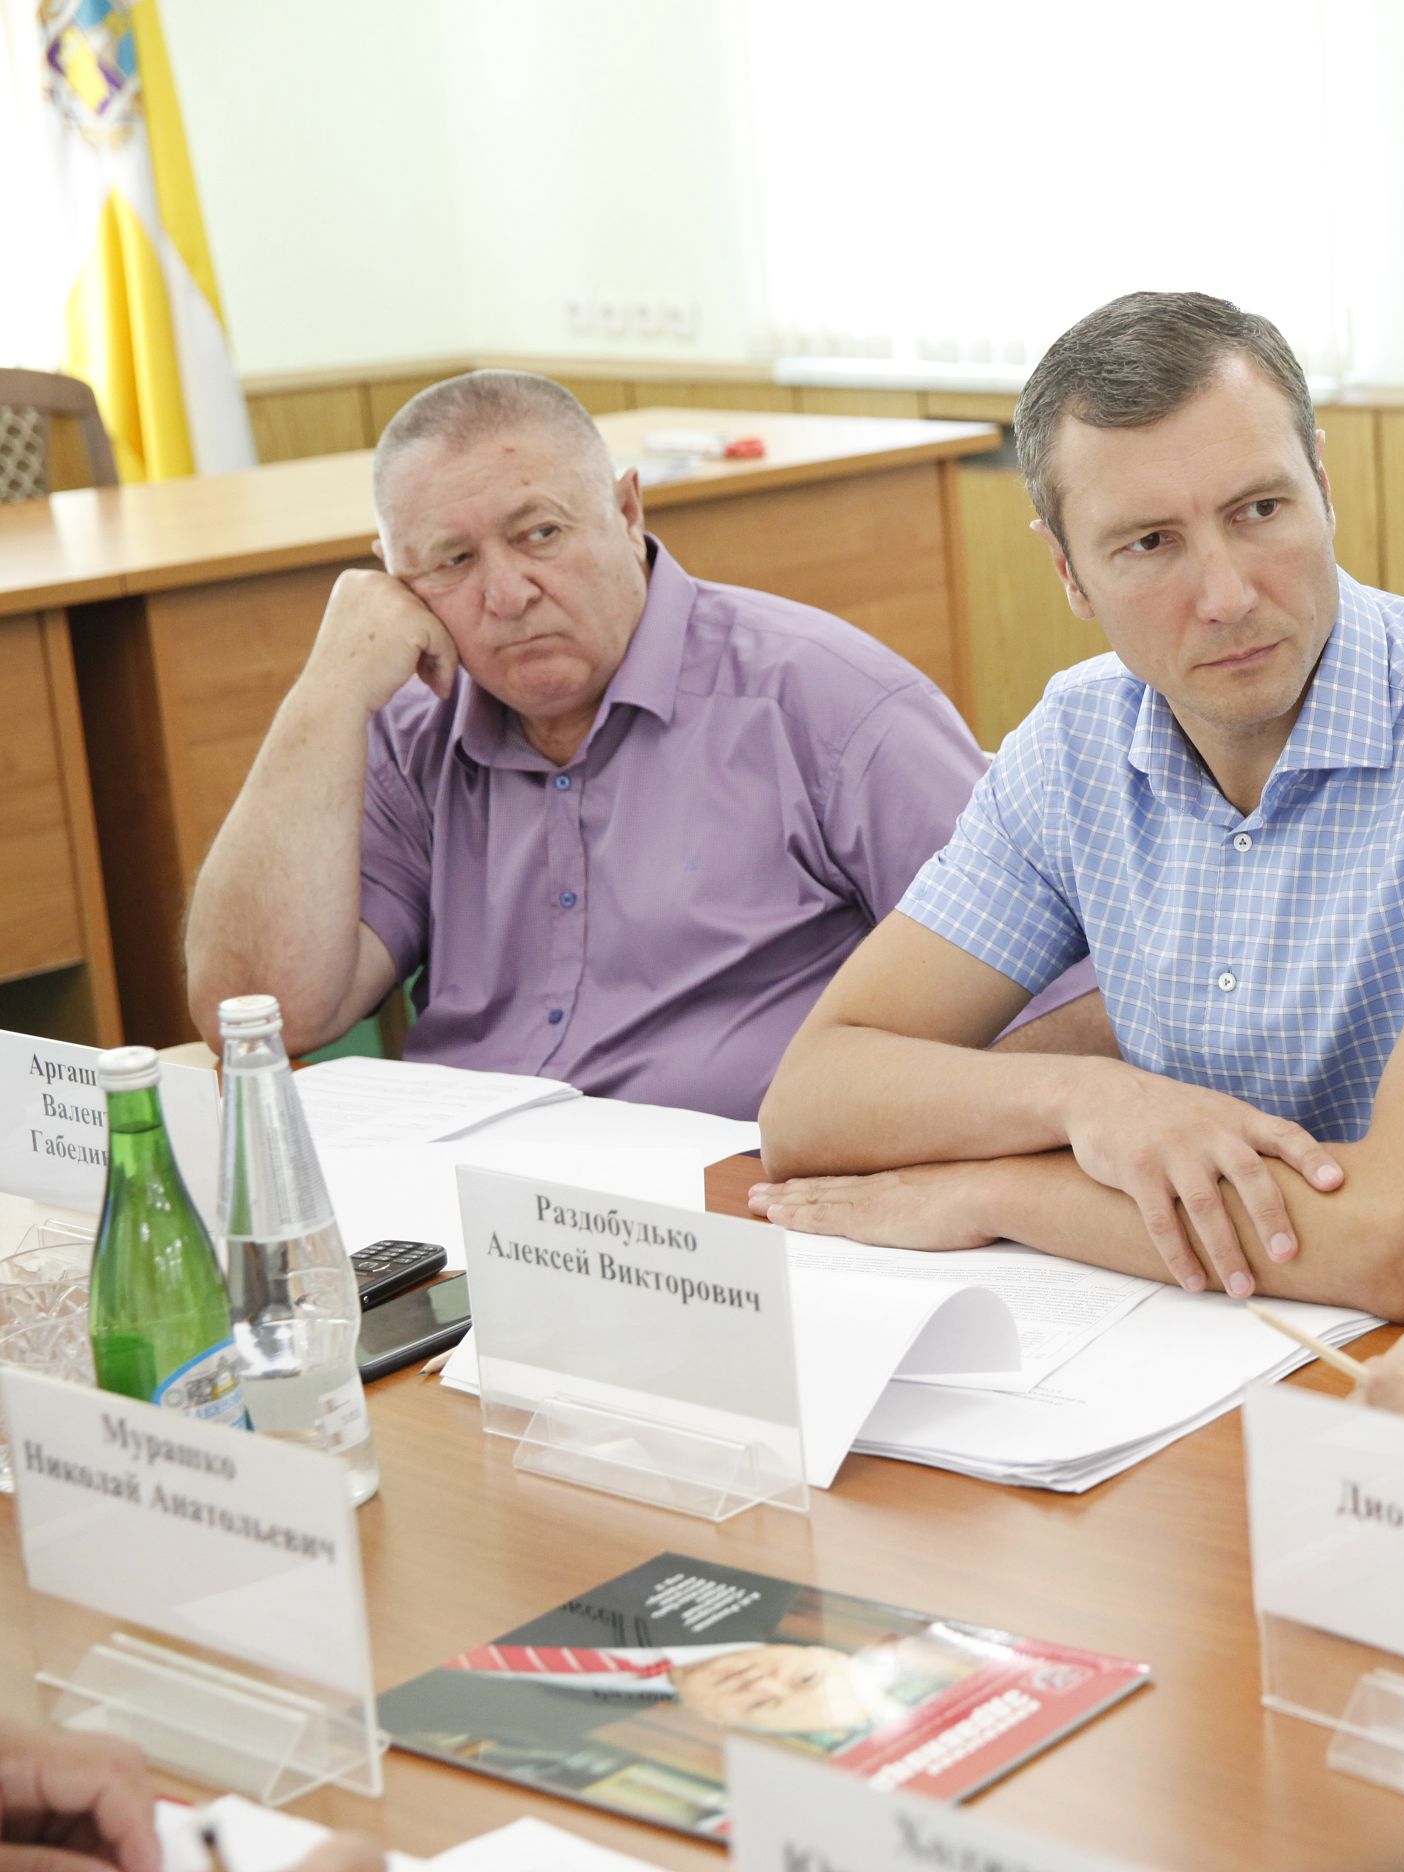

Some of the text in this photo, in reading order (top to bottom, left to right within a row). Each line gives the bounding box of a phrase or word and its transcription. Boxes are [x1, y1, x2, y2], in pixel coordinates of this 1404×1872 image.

[29, 1052, 98, 1087] Аргаш
[42, 1092, 108, 1127] Вален
[535, 1194, 698, 1253] Раздобудько
[486, 1231, 591, 1277] Алексей
[598, 1252, 761, 1313] Викторович
[101, 1412, 236, 1481] Мурашко
[23, 1440, 335, 1564] Николай Анатольевич
